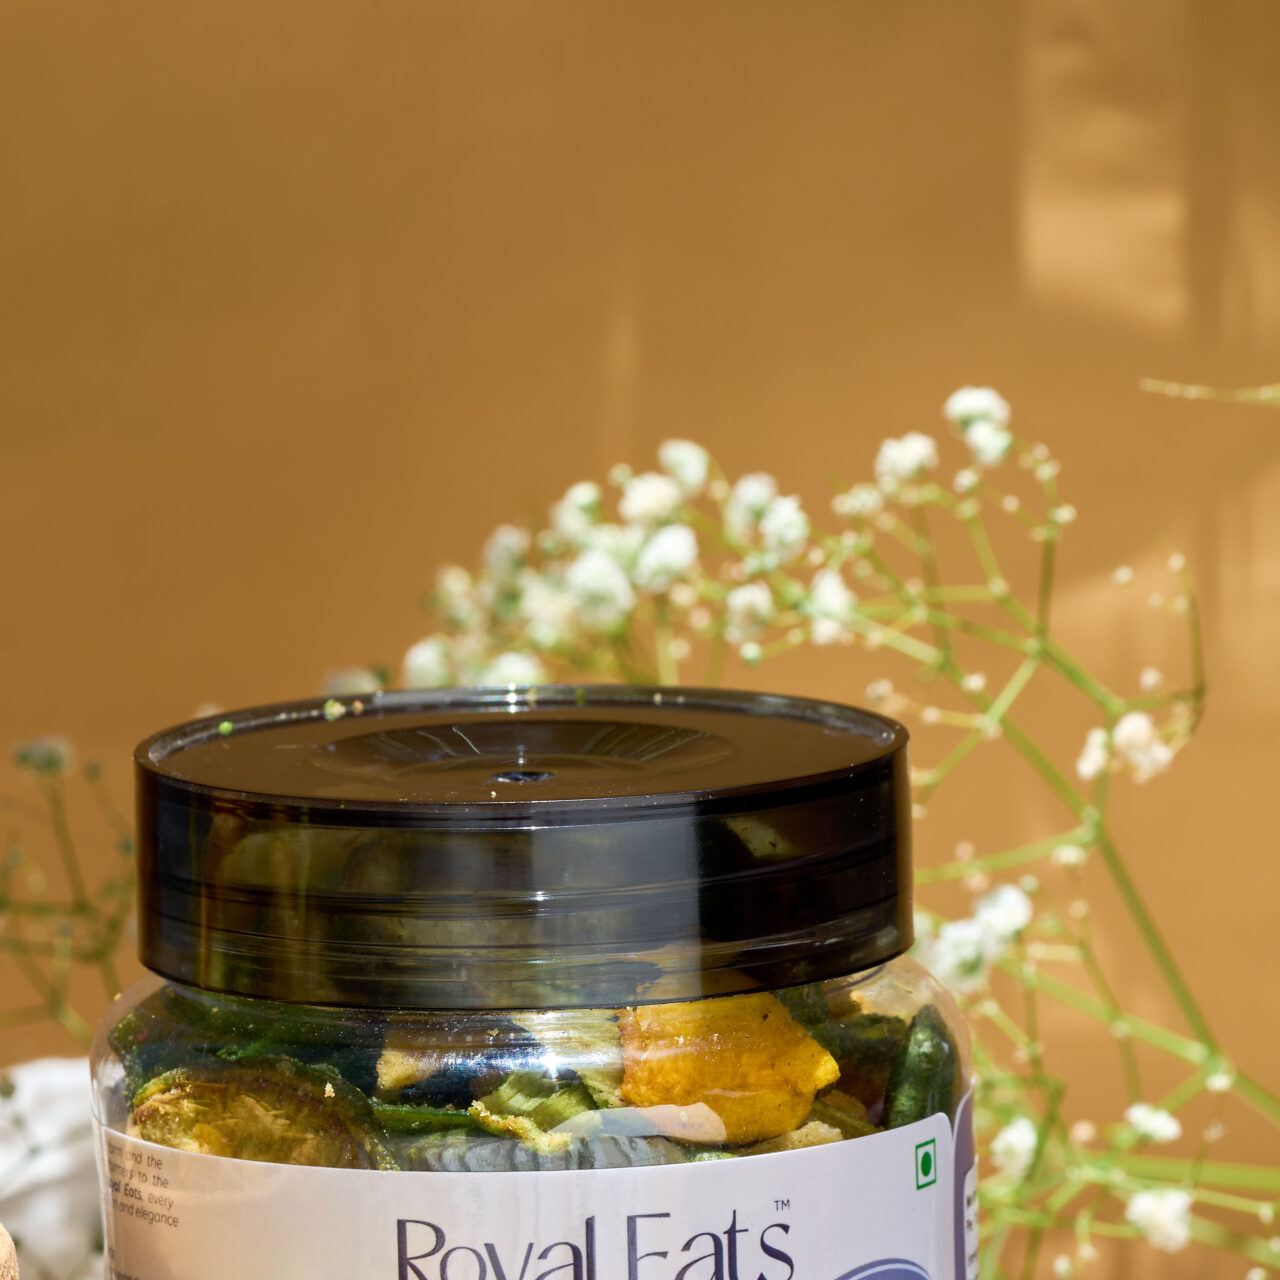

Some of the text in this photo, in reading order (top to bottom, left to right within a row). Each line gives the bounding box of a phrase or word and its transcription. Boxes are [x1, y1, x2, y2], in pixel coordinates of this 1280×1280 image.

[147, 1154, 163, 1170] the
[138, 1171, 148, 1183] to
[152, 1175, 169, 1189] the
[148, 1193, 174, 1211] every
[135, 1205, 179, 1227] elegance
